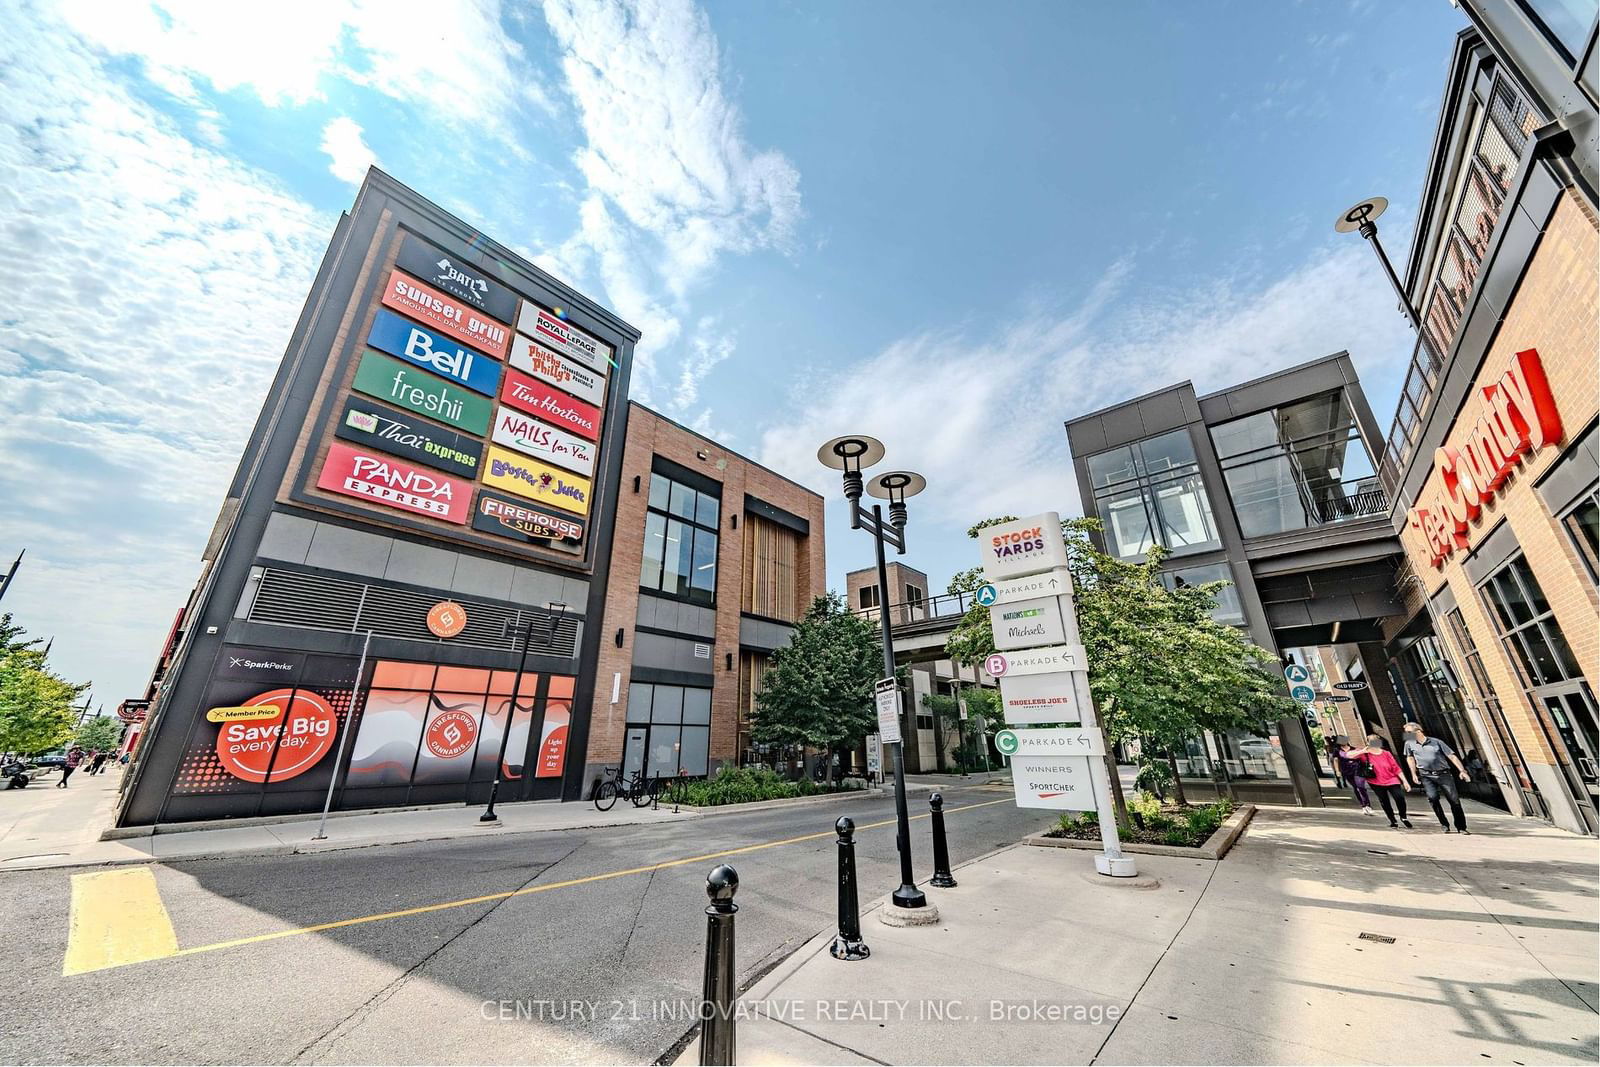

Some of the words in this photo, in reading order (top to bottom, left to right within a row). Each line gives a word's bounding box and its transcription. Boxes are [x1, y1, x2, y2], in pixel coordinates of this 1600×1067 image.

[448, 267, 475, 290] BATL
[391, 293, 426, 314] FAMOUS
[427, 312, 442, 321] ALL
[443, 319, 460, 330] DAY
[459, 326, 502, 350] BREAKFAST
[395, 280, 463, 323] sunset
[468, 317, 505, 344] grill
[536, 317, 565, 337] ROYAL
[404, 328, 474, 381] Bell
[528, 345, 561, 368] Philthy
[532, 357, 571, 382] Philly's
[391, 371, 463, 421] freshii
[512, 381, 539, 406] Tim
[540, 396, 593, 430] Hortons
[501, 416, 552, 446] NAILS
[551, 439, 568, 454] for
[572, 445, 590, 462] You
[424, 441, 476, 468] express
[352, 455, 453, 501] PANDA
[490, 458, 538, 488] Booster
[551, 479, 585, 503] Juice
[351, 481, 444, 513] EXPRESS
[484, 500, 579, 540] FIREHOUSE
[515, 520, 550, 537] SUBS
[991, 527, 1043, 547] STOCK
[993, 539, 1044, 558] YARDS
[979, 586, 995, 602] A
[999, 582, 1044, 596] PARKADE
[1008, 623, 1046, 638] Michaels
[243, 659, 293, 671] SparkPerks
[990, 658, 1004, 673] B
[1010, 656, 1058, 667] PARKADE
[1290, 666, 1305, 679] A
[225, 709, 257, 718] Member
[257, 708, 276, 716] Price
[1009, 698, 1047, 706] SHOELESS
[227, 723, 288, 742] Save
[292, 717, 330, 736] Big
[229, 739, 275, 754] every
[279, 735, 309, 748] day.
[431, 740, 466, 755] CANNABIS
[999, 734, 1015, 750] C
[1022, 738, 1073, 746] PARKADE
